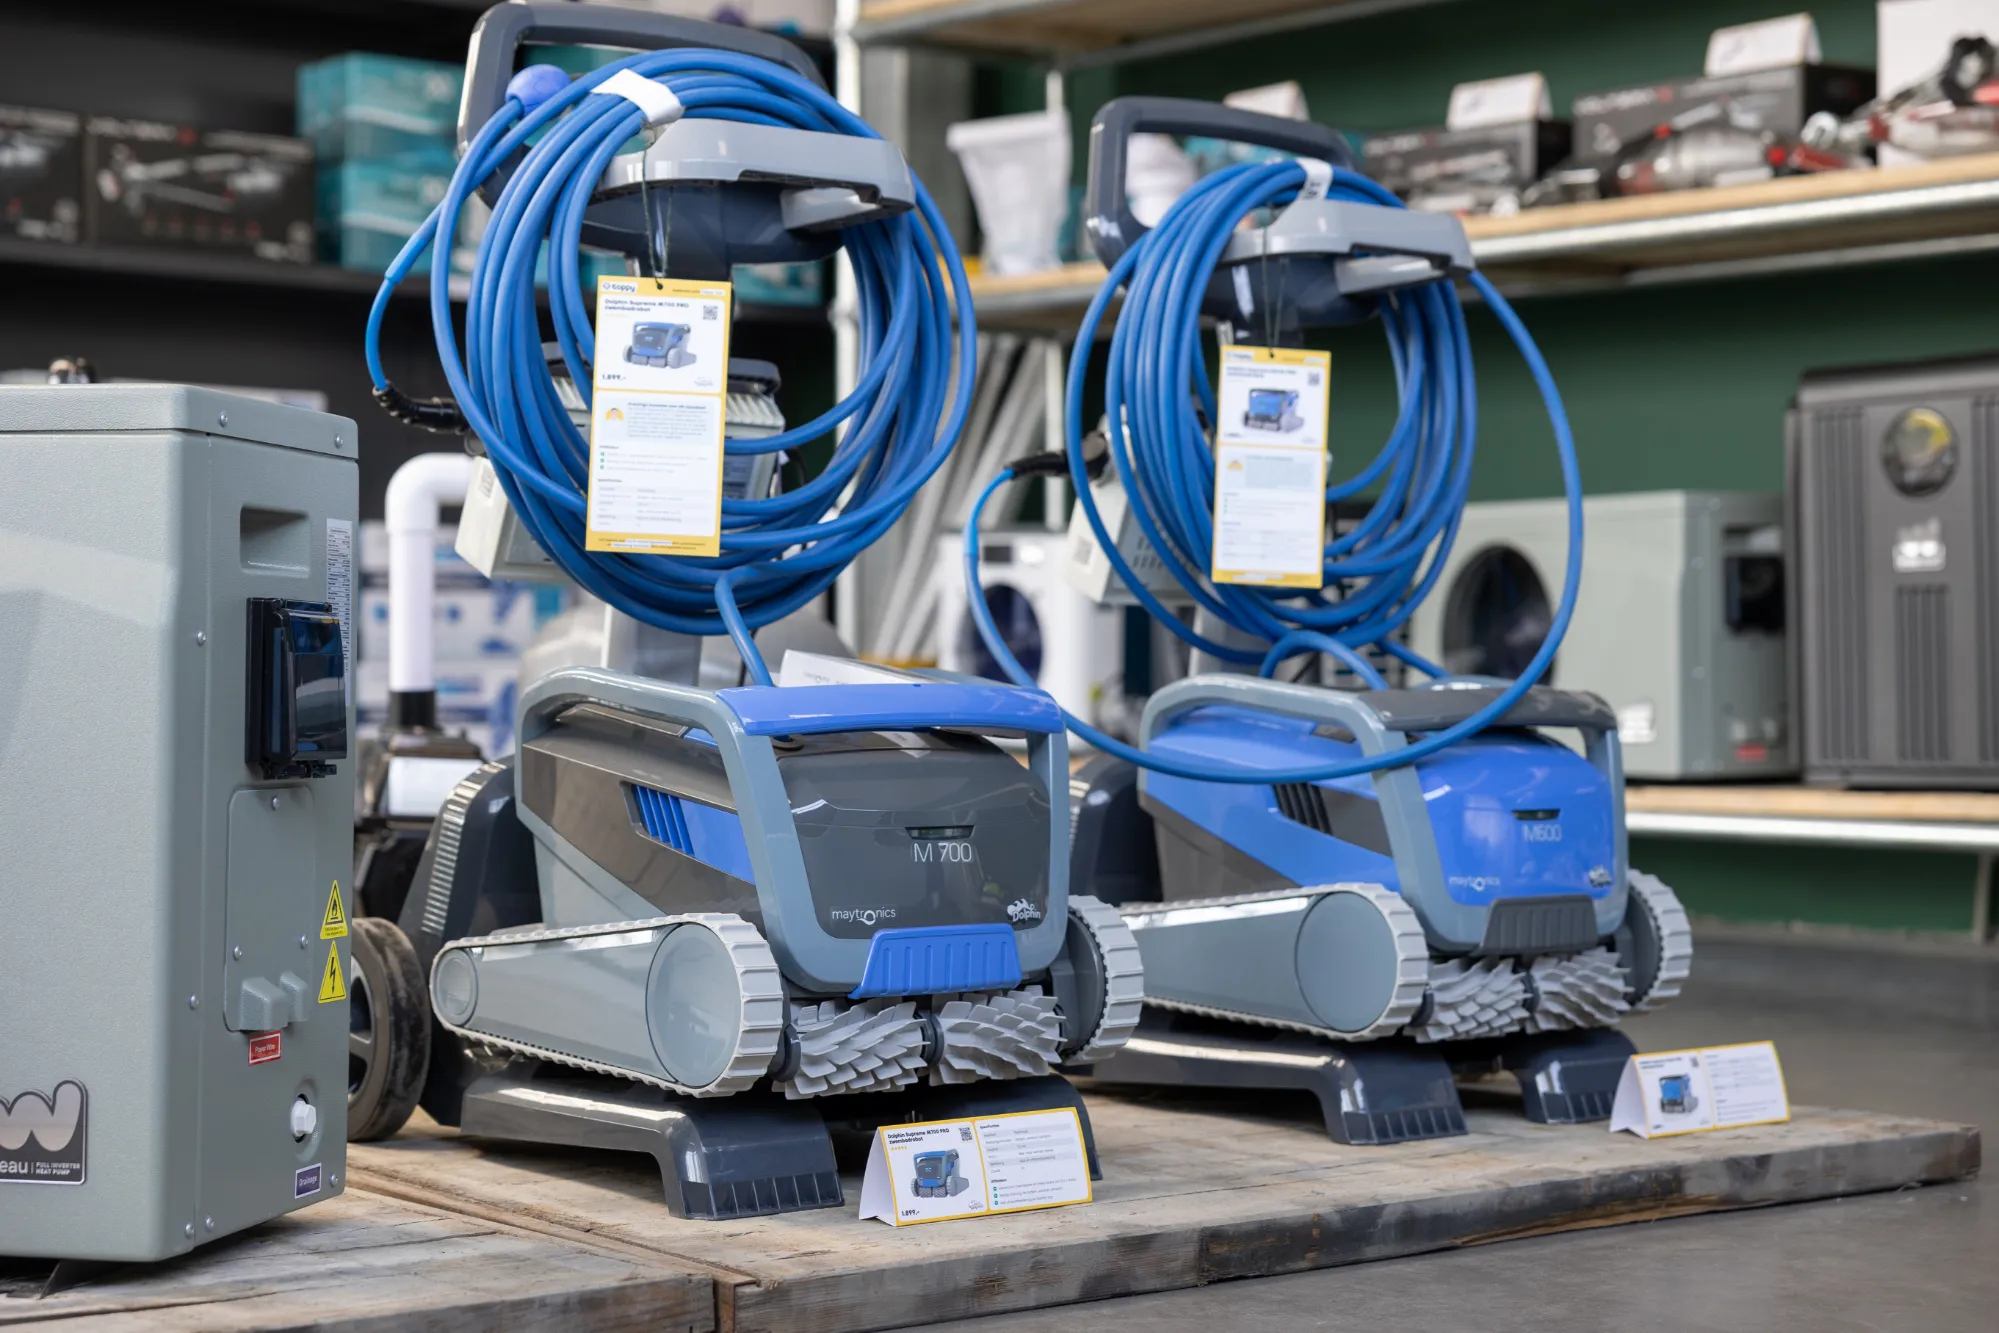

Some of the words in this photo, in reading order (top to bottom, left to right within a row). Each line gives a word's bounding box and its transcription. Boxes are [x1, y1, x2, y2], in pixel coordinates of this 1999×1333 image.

[612, 283, 636, 293] toppy
[913, 843, 933, 862] M
[938, 842, 973, 863] 700
[832, 907, 896, 926] maytronics
[1012, 906, 1041, 923] Dolphin
[887, 1132, 906, 1140] Dolphin
[905, 1130, 926, 1138] Supreme
[889, 1137, 924, 1145] zwembadrobot
[298, 1175, 318, 1187] Drainage
